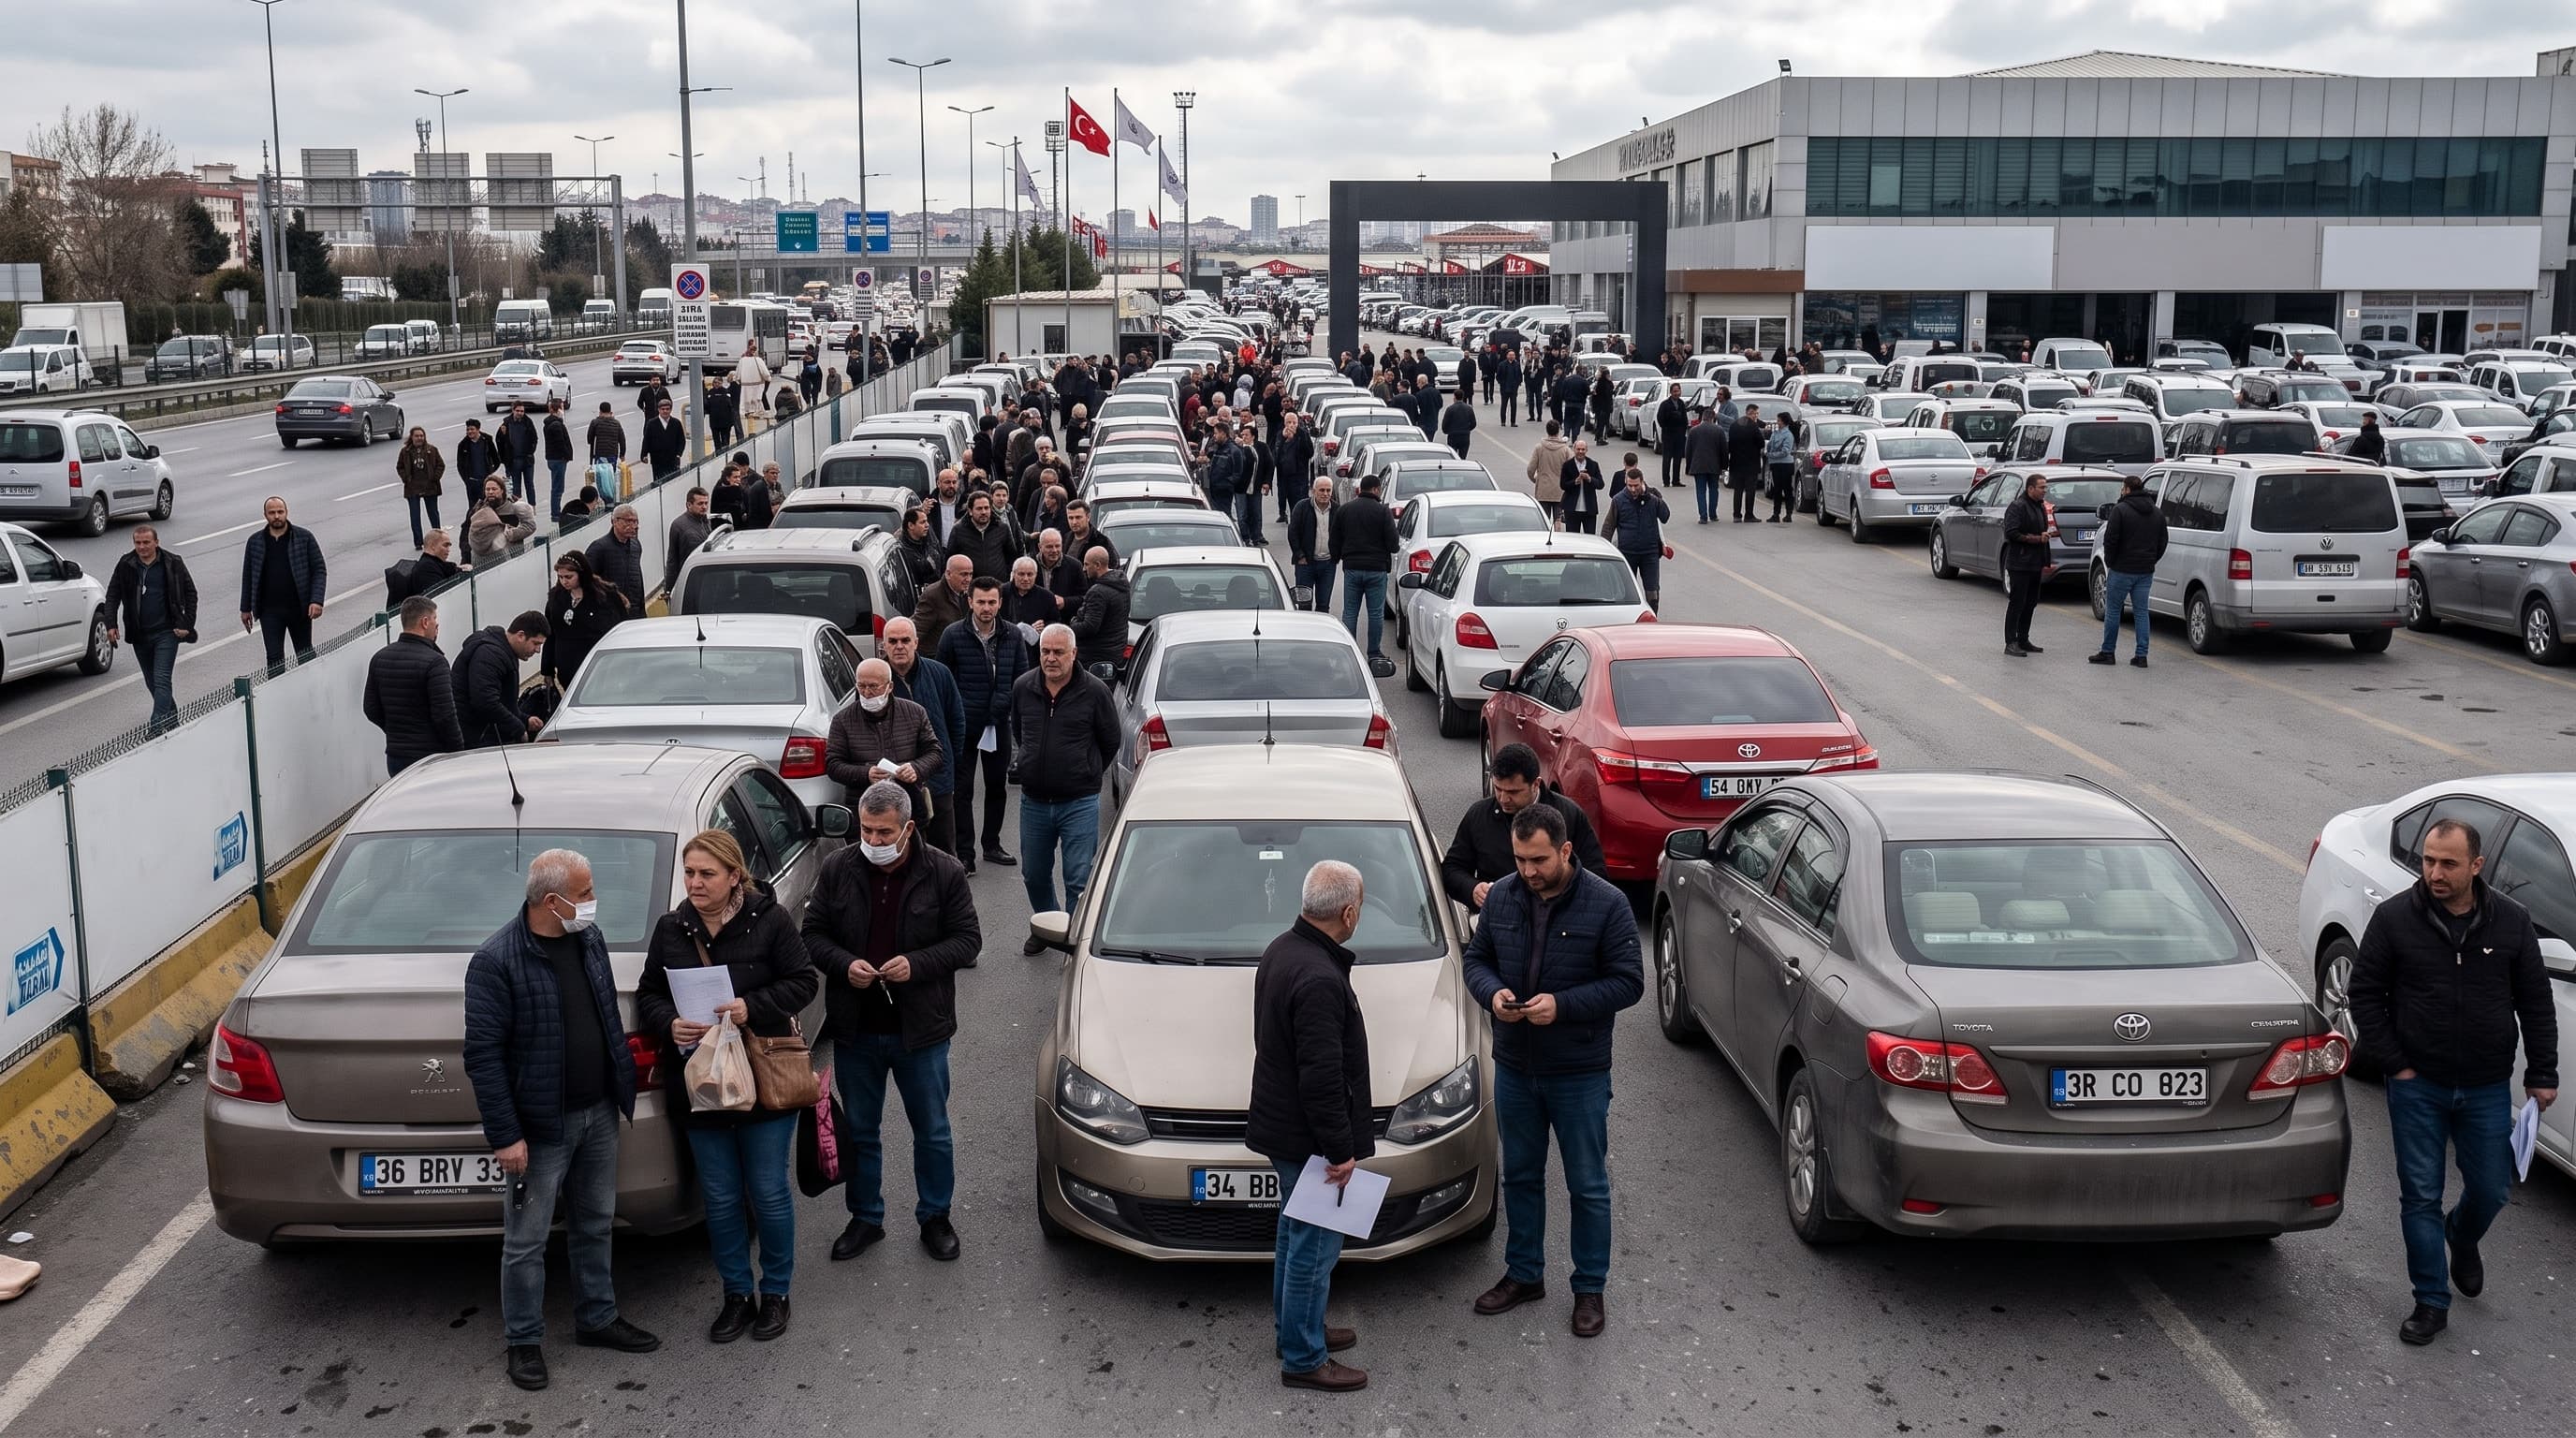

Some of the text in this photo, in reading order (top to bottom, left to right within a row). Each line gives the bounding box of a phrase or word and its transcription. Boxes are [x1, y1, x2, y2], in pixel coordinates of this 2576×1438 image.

[1711, 779, 1728, 795] 54
[2067, 1073, 2097, 1098] 3R
[2159, 1072, 2203, 1096] 823
[376, 1159, 405, 1184] 36
[419, 1158, 463, 1184] BRV
[1207, 1173, 1279, 1198] 34 BB
